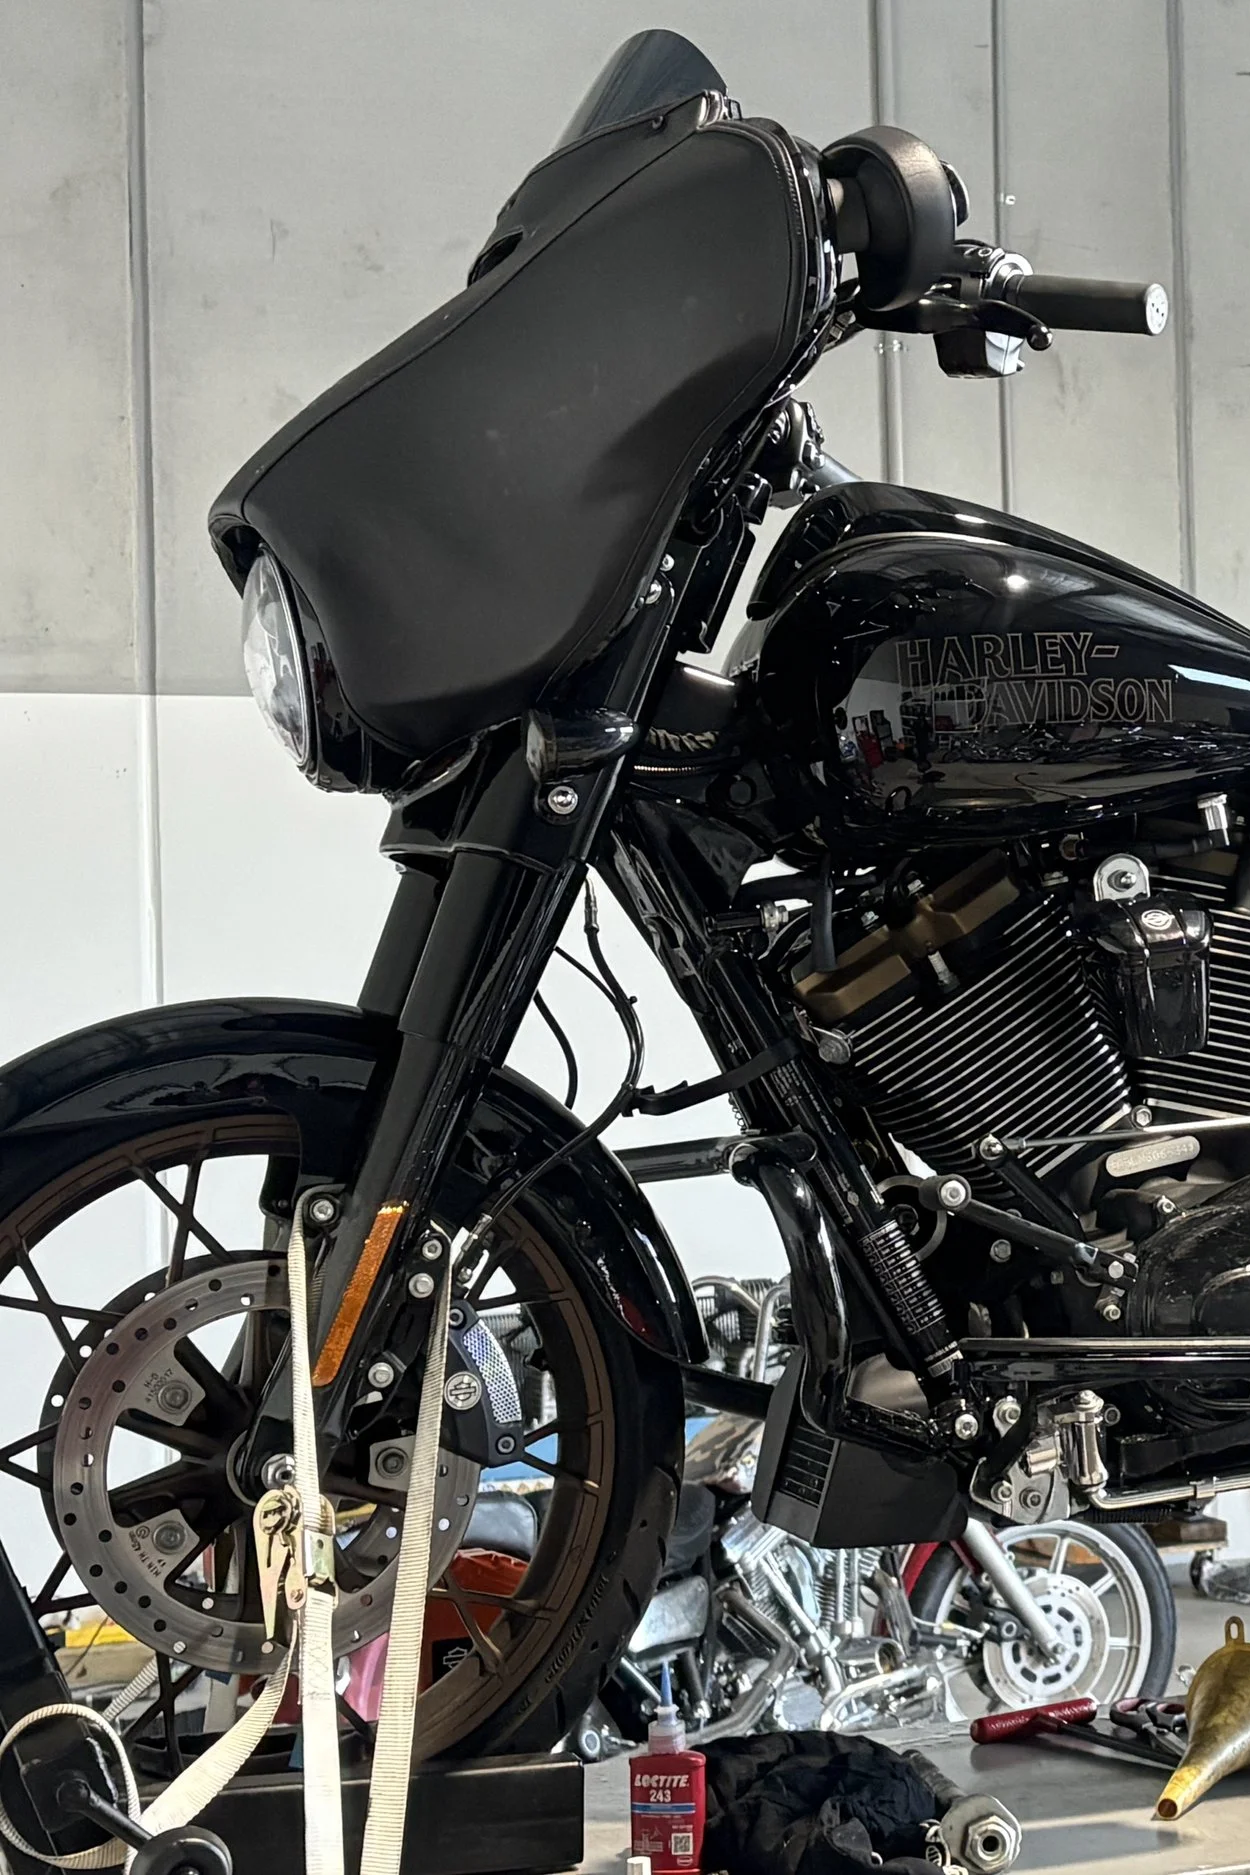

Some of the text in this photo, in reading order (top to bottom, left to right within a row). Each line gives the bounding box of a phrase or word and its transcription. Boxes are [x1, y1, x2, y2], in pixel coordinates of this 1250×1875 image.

[896, 632, 1120, 694] HARLEY-
[933, 677, 1173, 733] DAVIDSON
[634, 1774, 690, 1788] LOCTITE
[649, 1789, 672, 1803] 243
